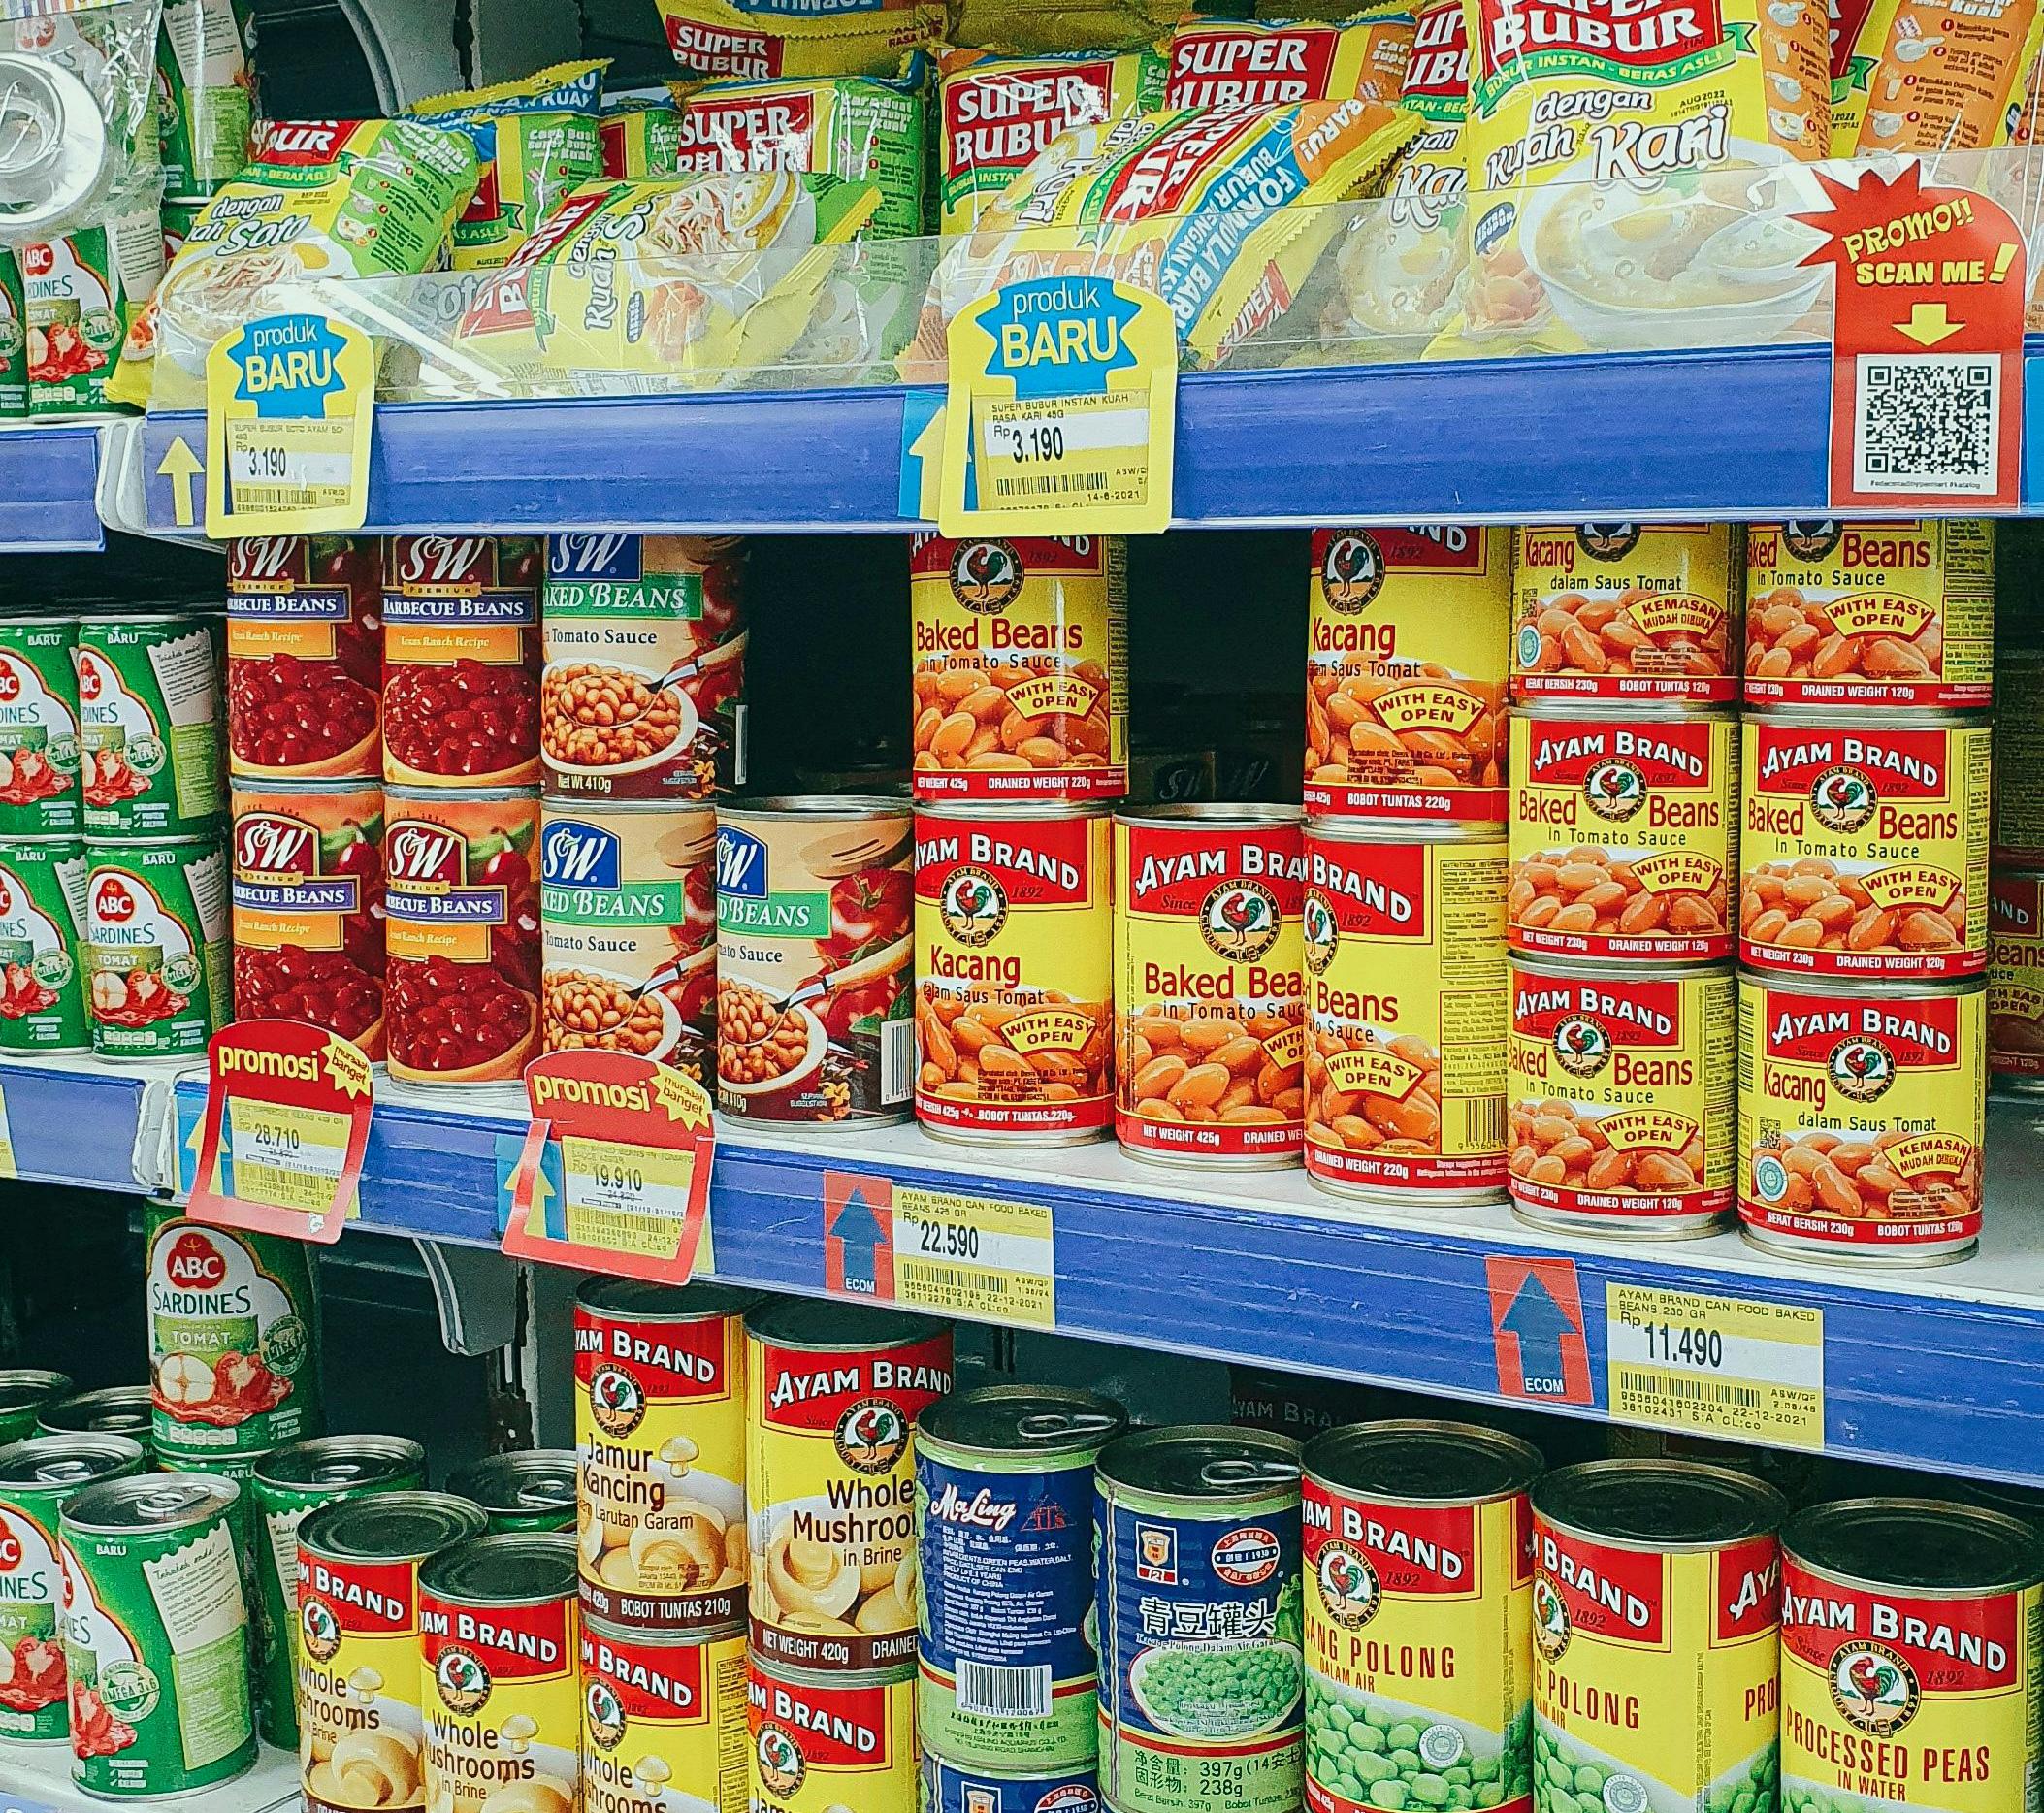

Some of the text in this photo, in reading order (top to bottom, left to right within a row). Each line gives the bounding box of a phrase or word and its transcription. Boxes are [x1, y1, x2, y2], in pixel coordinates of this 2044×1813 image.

[677, 26, 768, 53] SUPER
[1493, 7, 1704, 52] BUBUR
[1174, 39, 1307, 76] SUPER
[1537, 54, 1605, 70] INSTAN
[1620, 62, 1678, 80] BERAS
[1681, 50, 1723, 74] ASLI
[1536, 89, 1651, 123] dengan
[679, 106, 793, 147] SUPER
[1303, 98, 1366, 163] BARU!
[1488, 107, 1731, 190] Kuah Kari
[1216, 147, 1277, 208] BUBUR
[211, 193, 284, 221] dengan
[215, 214, 312, 256] Soto
[1857, 262, 1936, 284] SCAN
[584, 248, 618, 330] Kuah
[1013, 279, 1100, 321] produk
[254, 318, 318, 355] produk
[1002, 317, 1118, 368] BARU
[245, 349, 332, 393] BARU
[992, 394, 1128, 413] SUPER BUBUR INSTAN KUAH
[992, 410, 1064, 423] RASA KARI 45G
[994, 425, 1064, 463] Rp 3.190
[249, 447, 286, 477] 3.190
[1843, 534, 1930, 567] Beans
[1550, 574, 1630, 590] dalam Saus
[1770, 570, 1823, 586] Tomato
[275, 594, 337, 612] BEANS
[459, 596, 524, 616] BEANS
[589, 582, 686, 610] BEANS
[1642, 598, 1721, 619] KEMASAN
[552, 628, 658, 645] Tomato Sauce
[916, 618, 1083, 651] Baked Beans
[1643, 613, 1678, 630] MUDAH
[1313, 617, 1396, 660] Kacang
[943, 655, 999, 669] Tomato
[1368, 661, 1421, 678] Tomat
[1011, 681, 1097, 701] WITH EASY
[1032, 695, 1078, 709] OPEN
[1891, 686, 1914, 700] 120g
[1401, 709, 1455, 724] OPEN
[1534, 730, 1703, 777] AYAM BRAND
[1763, 738, 1938, 787] AYAM BRAND
[585, 776, 611, 793] 410g
[989, 776, 1091, 790] DRAINED WEIGHT 220g
[1425, 795, 1451, 811] 220g
[1519, 789, 1719, 827] Baked Beans
[1879, 806, 1958, 840] Beans
[143, 854, 176, 865] BARU
[970, 833, 1080, 890] BRAND
[1137, 850, 1226, 896] AYAM
[1313, 852, 1412, 923] BRAND
[588, 935, 637, 953] Sauce
[739, 945, 783, 963] Sauce
[931, 944, 1021, 989] Kacang
[1145, 962, 1234, 999] Baked
[996, 988, 1045, 1006] Tomat
[1579, 987, 1671, 1036] BRAND
[219, 1046, 319, 1082] promosi
[332, 1056, 368, 1085] banget
[534, 1074, 651, 1113] promosi
[663, 1085, 704, 1117] banget
[1763, 1063, 1826, 1111] Kacang
[255, 1123, 300, 1149] 28.710
[1849, 1116, 1887, 1132] Saus
[594, 1164, 642, 1191] 19.910
[901, 1191, 927, 1203] AYAM
[966, 1200, 985, 1211] CAN
[990, 1204, 1014, 1214] FOOD
[1019, 1207, 1048, 1218] BAKED
[903, 1213, 979, 1259] Rp 22.590
[171, 1256, 221, 1279] ABC
[152, 1283, 252, 1315] SARDINES
[845, 1277, 875, 1292] ECOM
[987, 1293, 1043, 1310] 22-12-2021
[1618, 1289, 1815, 1322] AYAM BRAND CAN FOOD BAKED
[1619, 1301, 1657, 1314] BEANS
[1664, 1307, 1683, 1317] 230
[172, 1330, 231, 1344] TOMAT
[1620, 1311, 1722, 1368] Rp 11.490
[1524, 1377, 1566, 1394] ECOM
[1733, 1407, 1807, 1426] 22-12-2021
[588, 1432, 654, 1473] Jamur
[582, 1463, 666, 1512] Kancing
[827, 1474, 915, 1511] Whole
[595, 1503, 694, 1530] Larutan Garam
[793, 1509, 918, 1544] Mushroo
[96, 1545, 127, 1556] BARU
[843, 1547, 902, 1567] in Brine
[1384, 1571, 1421, 1588] 1892
[621, 1597, 730, 1619] BOBOT TUNTAS 210g
[1139, 1595, 1278, 1638] 青豆罐头
[762, 1631, 849, 1664] NET WEIGHT 420g
[1349, 1636, 1456, 1680] POLONG
[1319, 1659, 1376, 1694] DALAM AIR
[102, 1685, 135, 1700] OMEGA
[1547, 1668, 1639, 1730] POLONG
[432, 1709, 499, 1750] Whole
[1786, 1703, 1990, 1783] PROCESSED PEAS
[1199, 1761, 1243, 1780] 397g
[1837, 1769, 1906, 1802] IN WATER
[454, 1779, 487, 1800] Brine
[1199, 1779, 1243, 1797] 238g
